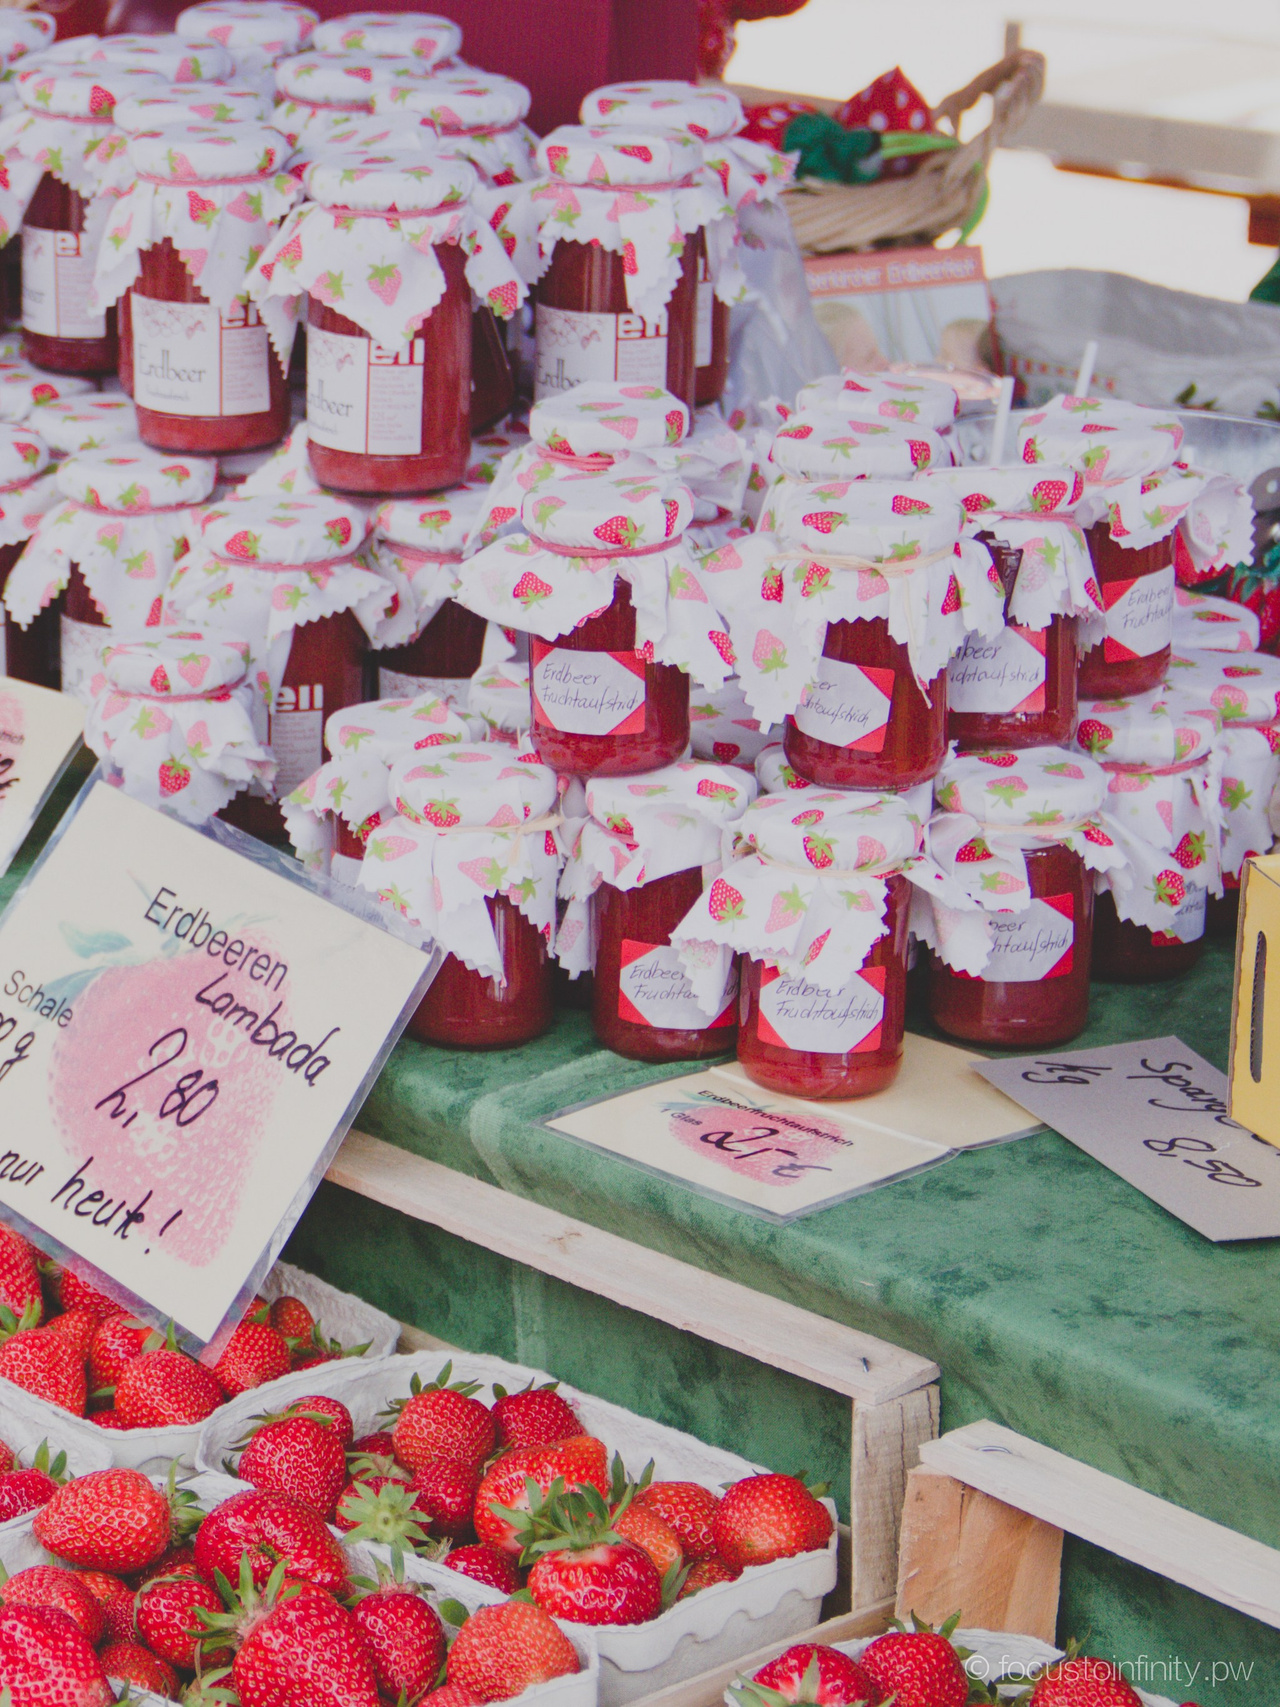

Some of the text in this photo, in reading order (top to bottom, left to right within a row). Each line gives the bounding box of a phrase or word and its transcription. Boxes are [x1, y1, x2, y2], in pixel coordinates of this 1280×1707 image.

[137, 343, 207, 383] Erdbeer
[277, 684, 324, 711] ell
[541, 662, 601, 687] Erdbeer
[143, 886, 288, 993] Erdbeeren
[3, 969, 74, 1029] Schale
[194, 972, 341, 1088] Lambada
[94, 1027, 220, 1129] 2,80
[669, 1111, 704, 1127] Glas
[697, 1089, 855, 1148] Erdbeerfruchtaufstrich
[1142, 1136, 1263, 1188] 8,50
